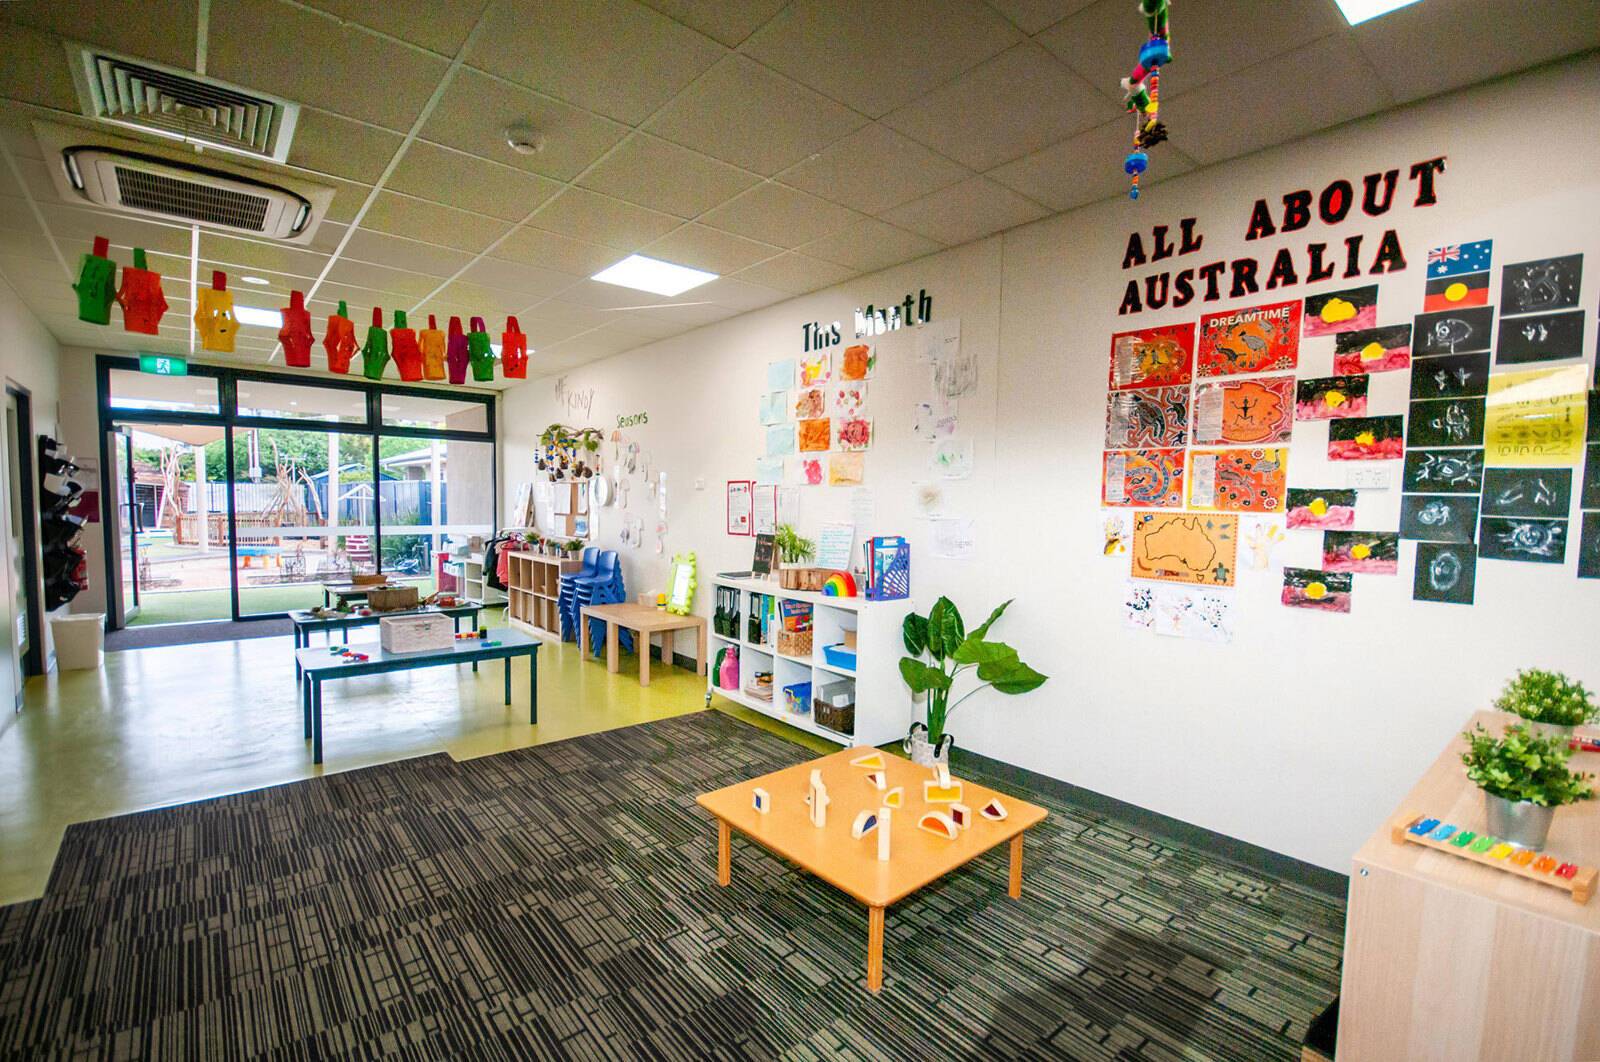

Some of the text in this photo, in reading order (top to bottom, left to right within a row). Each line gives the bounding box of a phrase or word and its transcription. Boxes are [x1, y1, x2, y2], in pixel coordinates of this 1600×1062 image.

[1122, 156, 1447, 269] ALL ABOUT
[1118, 229, 1407, 316] AUSTRALIA
[802, 288, 932, 353] This Month
[1209, 307, 1290, 328] DREAMTIME
